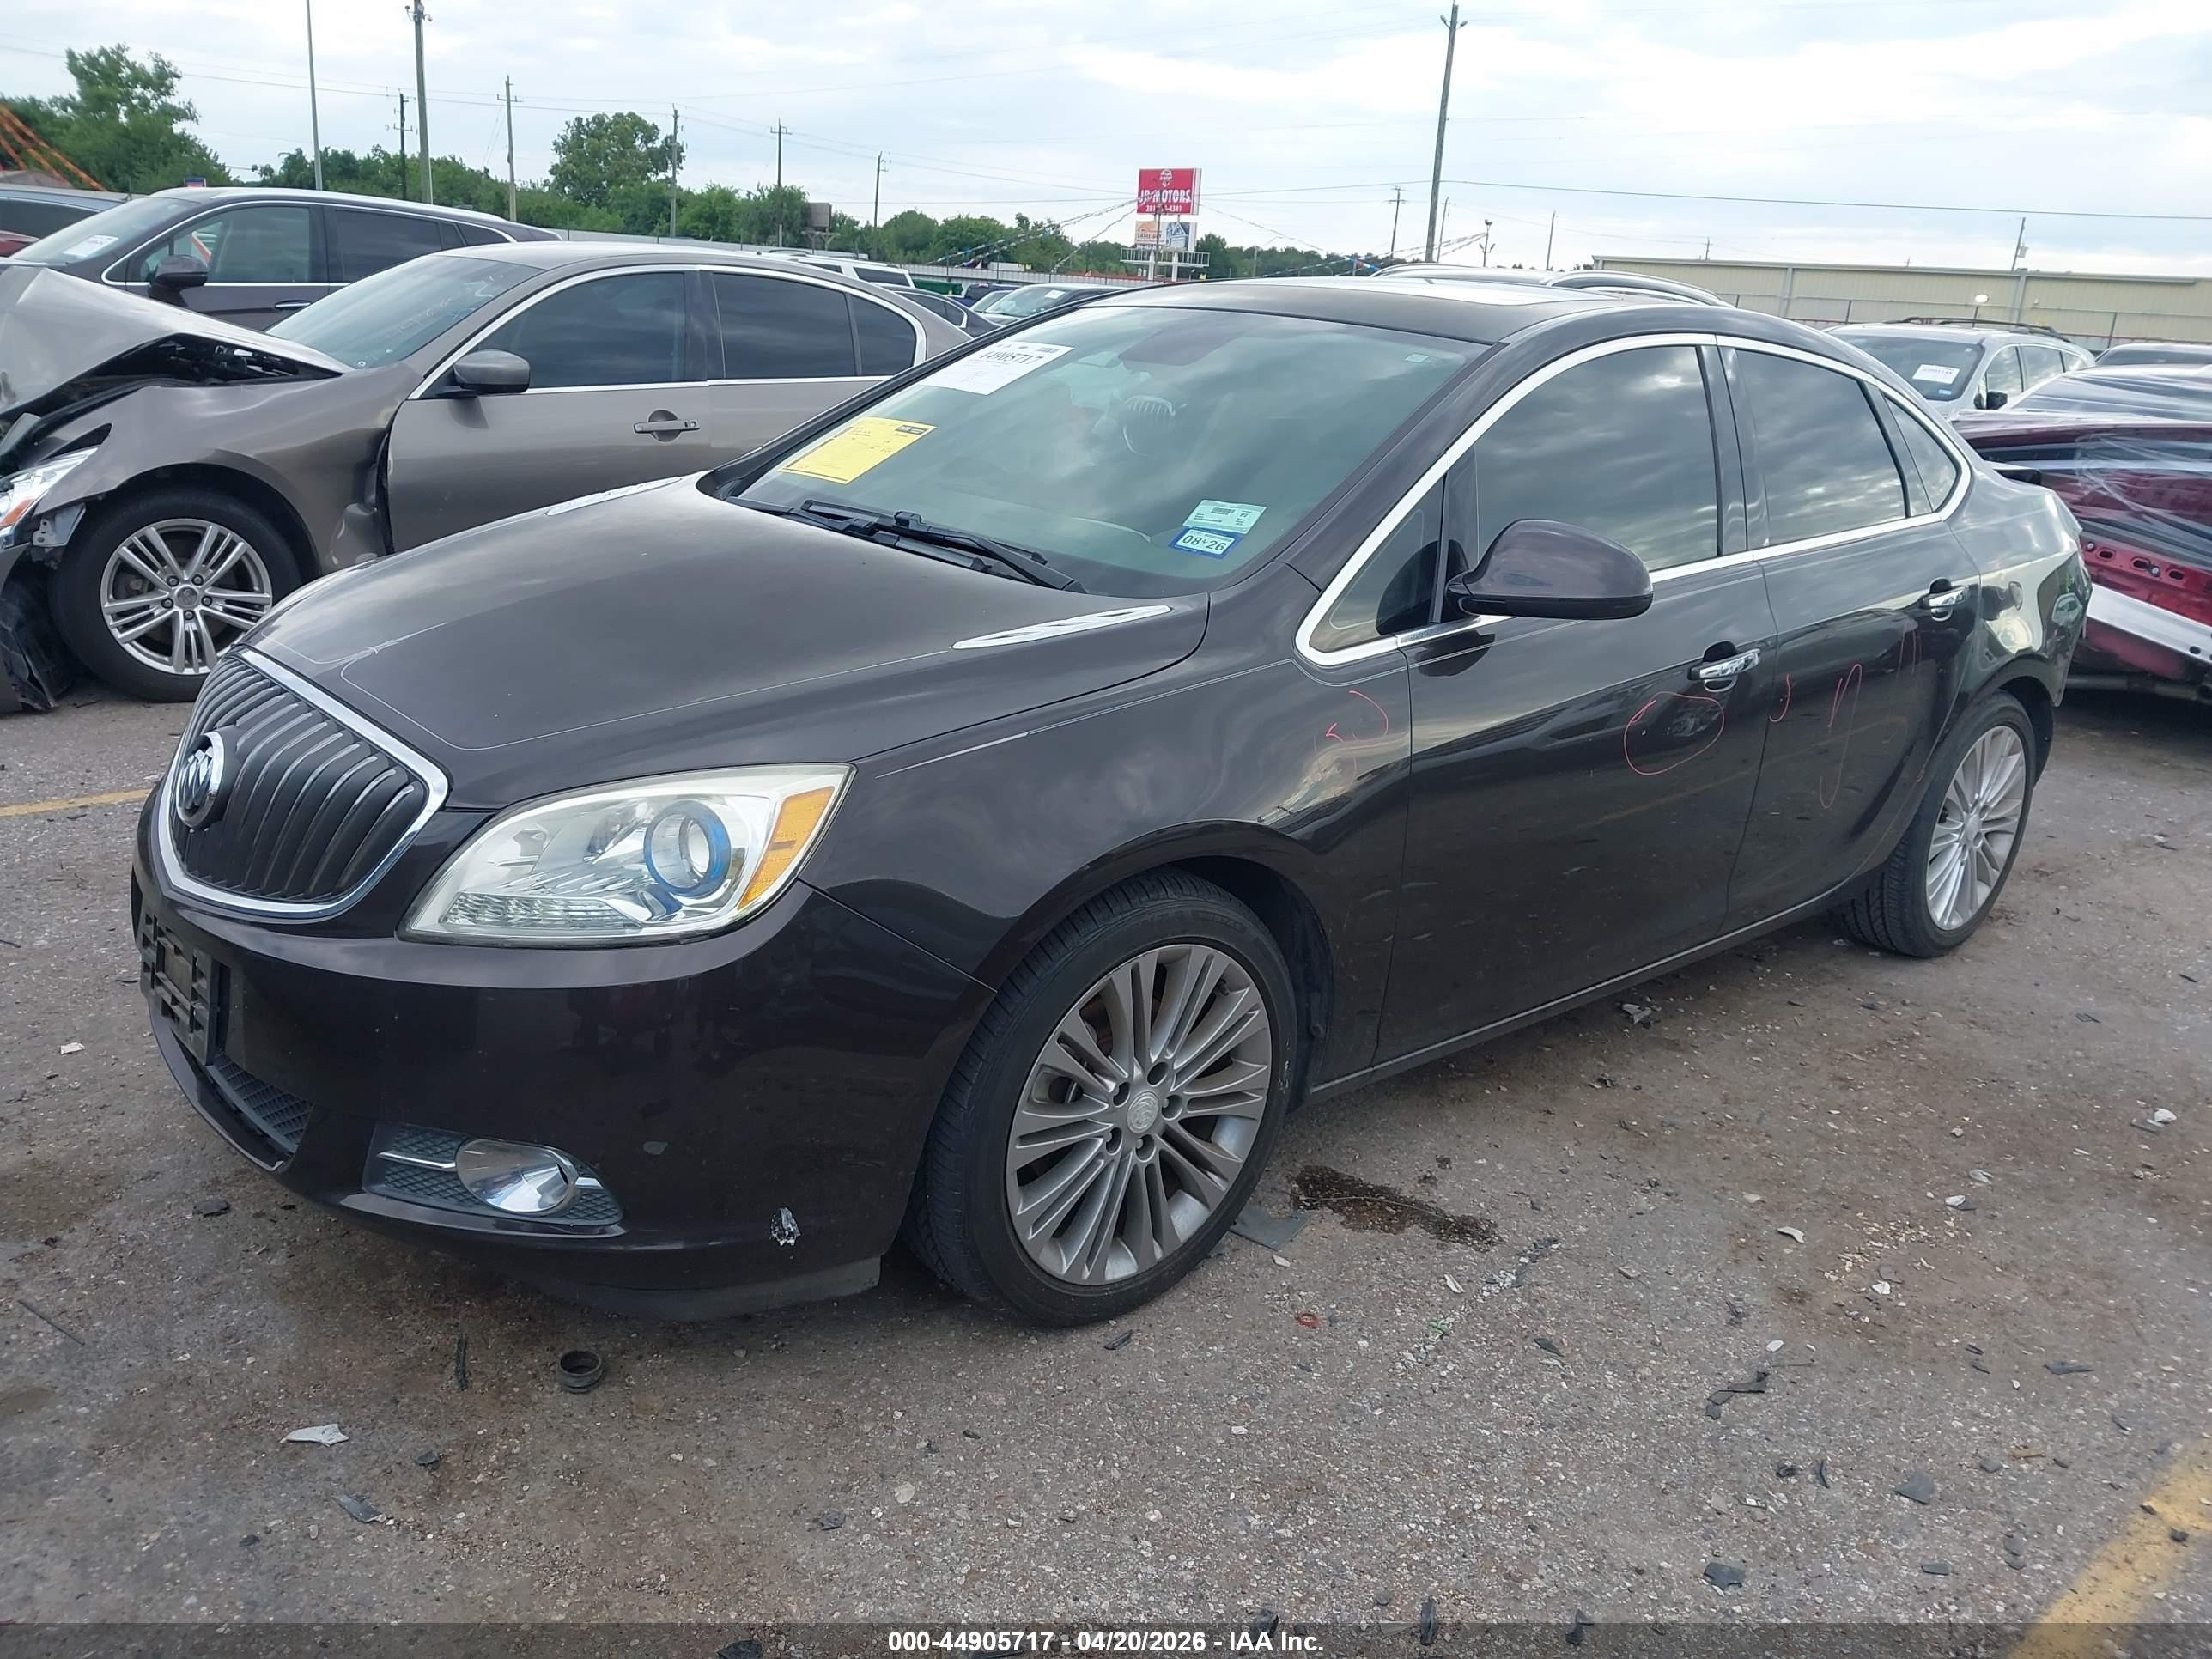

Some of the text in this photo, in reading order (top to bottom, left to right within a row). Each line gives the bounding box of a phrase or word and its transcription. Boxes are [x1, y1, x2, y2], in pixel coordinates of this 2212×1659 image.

[1152, 190, 1191, 203] MOTORS
[1182, 535, 1202, 545] 08
[1206, 541, 1226, 550] 26
